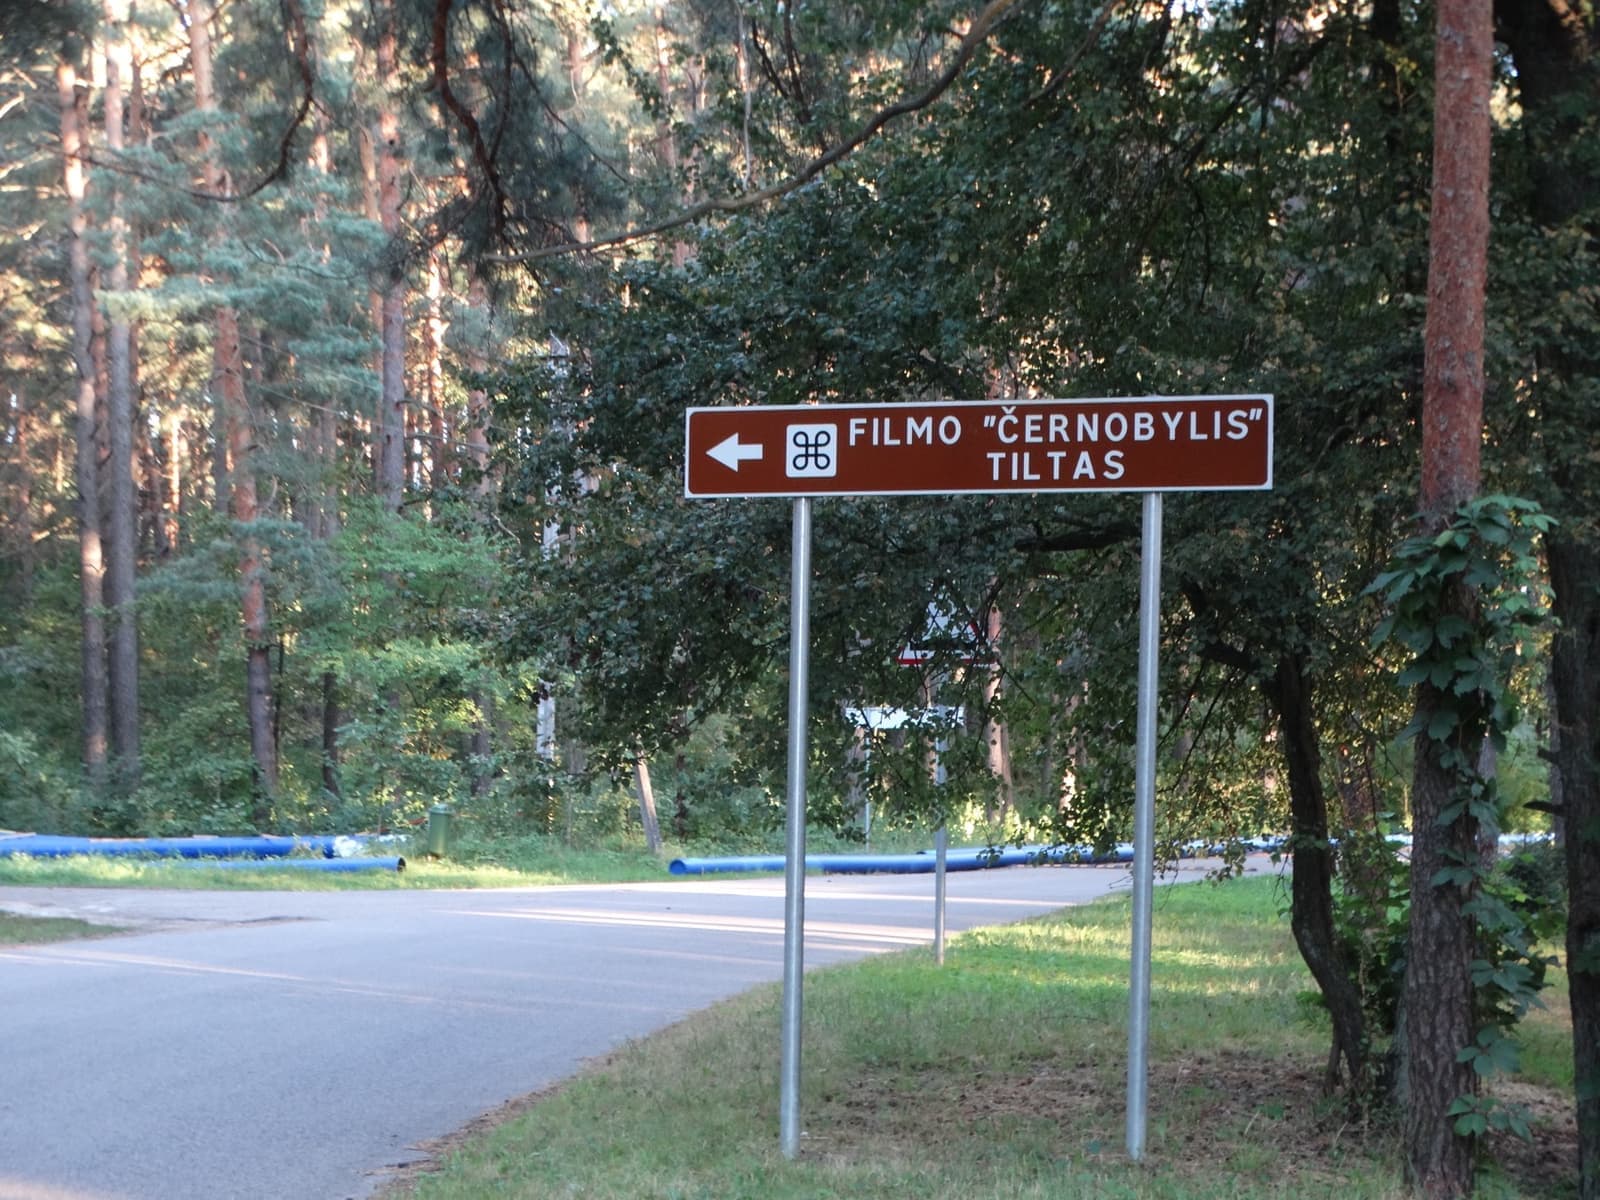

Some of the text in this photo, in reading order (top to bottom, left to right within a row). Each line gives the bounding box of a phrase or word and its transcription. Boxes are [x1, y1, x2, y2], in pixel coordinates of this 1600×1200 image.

[849, 406, 1263, 447] FILMO "ČERNOBYLIS"
[986, 449, 1126, 482] TILTAS
